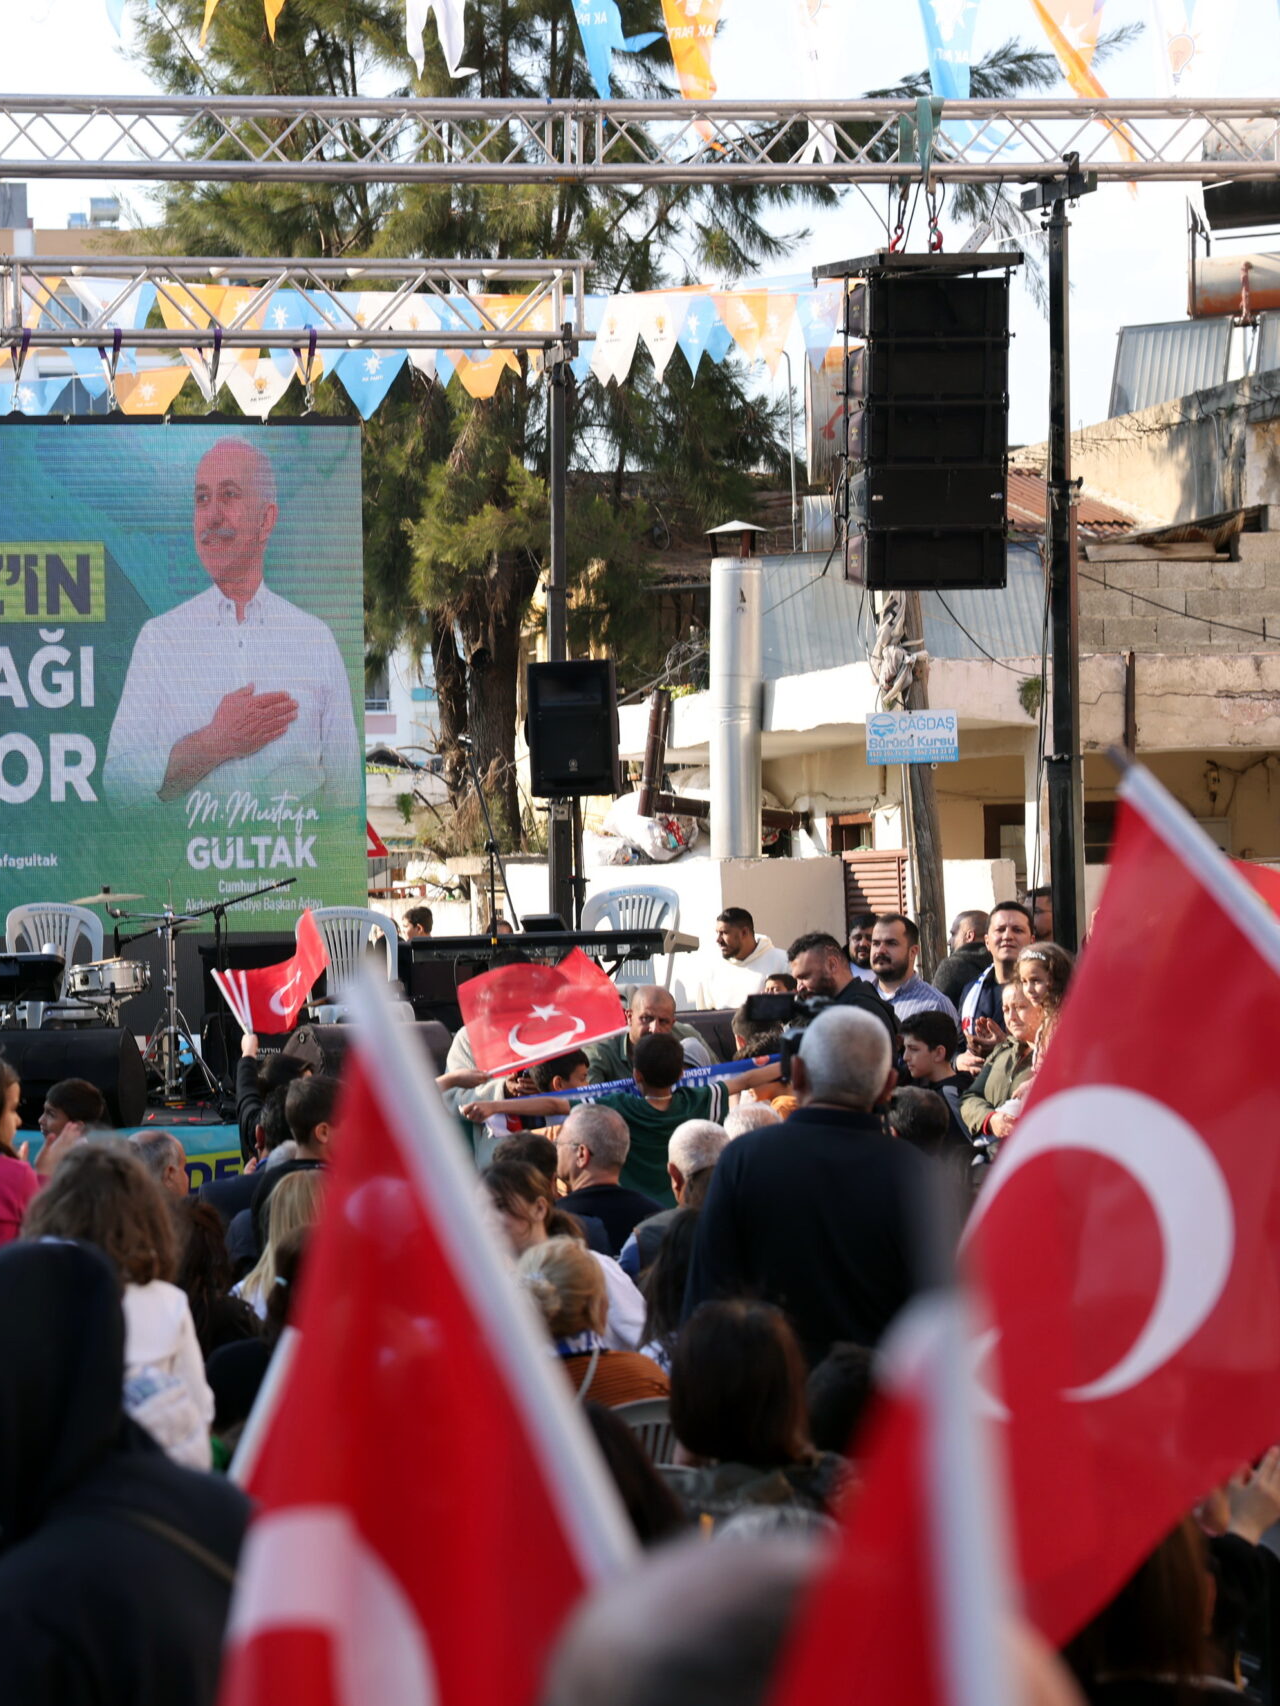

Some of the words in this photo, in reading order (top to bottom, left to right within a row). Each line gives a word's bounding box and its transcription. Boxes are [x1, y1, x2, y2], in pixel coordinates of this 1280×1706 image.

[898, 715, 955, 734] ÇAĞDAŞ
[917, 735, 955, 747] Kursu
[187, 834, 318, 870] GÜLTAK
[263, 897, 297, 915] Başkan
